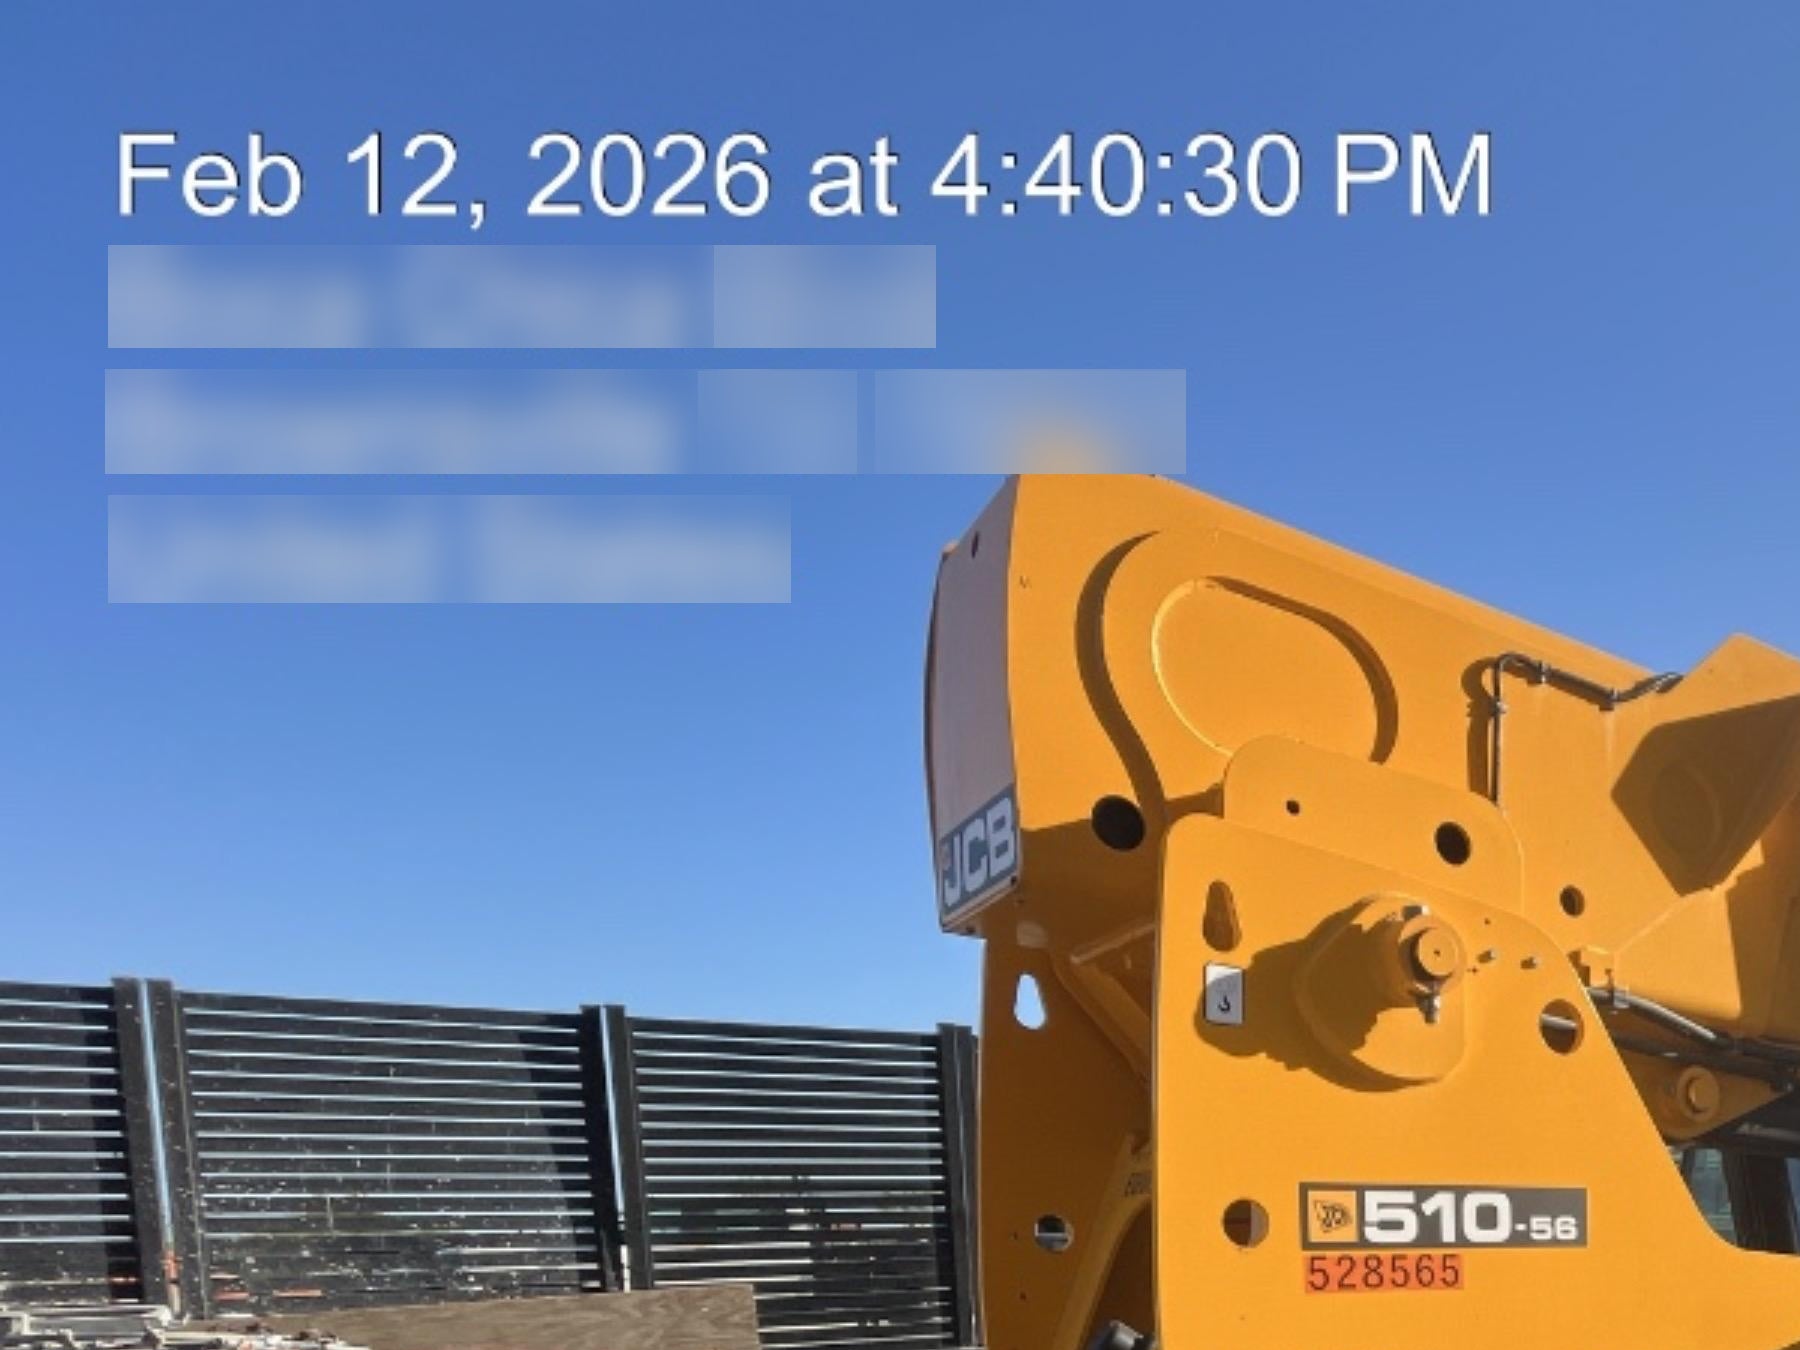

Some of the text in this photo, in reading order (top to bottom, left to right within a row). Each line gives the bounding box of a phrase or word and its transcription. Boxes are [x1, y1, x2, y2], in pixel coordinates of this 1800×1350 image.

[943, 797, 1015, 906] JCB
[1363, 1190, 1579, 1243] 510-56
[1307, 1254, 1461, 1290] 528565
